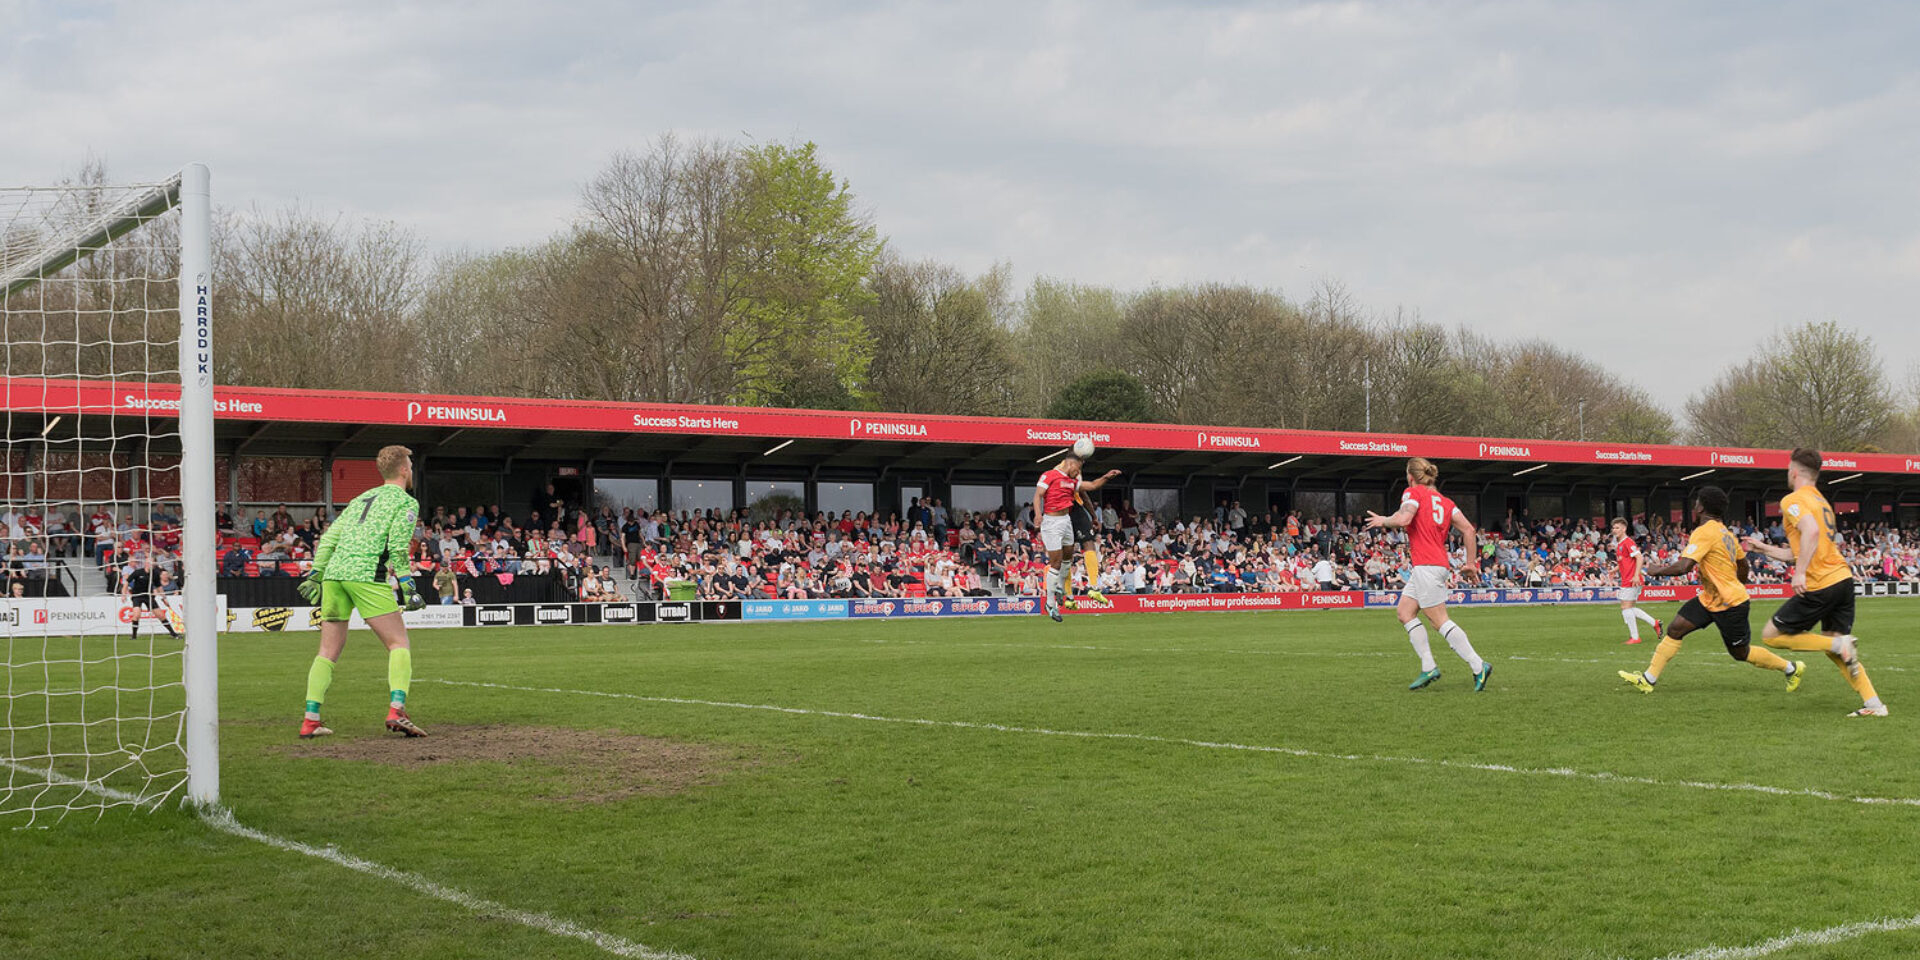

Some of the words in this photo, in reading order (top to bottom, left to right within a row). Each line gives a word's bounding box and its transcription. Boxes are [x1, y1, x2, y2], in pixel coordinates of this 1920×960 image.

[196, 285, 208, 349] HARROD
[198, 353, 208, 373] UK
[125, 395, 181, 410] Success
[229, 399, 262, 413] Here
[428, 406, 506, 422] PENINSULA
[633, 414, 677, 427] Success
[679, 416, 712, 428] Starts
[713, 417, 739, 429] Here
[866, 423, 928, 436] PENINSULA
[1026, 429, 1061, 440] Success
[1062, 430, 1088, 441] Starts
[1089, 431, 1110, 442] Here
[1210, 436, 1260, 447] PENINSULA
[1340, 440, 1367, 451] Success
[1368, 441, 1389, 452] Starts
[1390, 443, 1408, 453] Here
[1489, 446, 1530, 457] PENINSULA
[1595, 450, 1618, 460] Success
[1619, 451, 1637, 460] Starts
[1638, 452, 1652, 461] Here
[1720, 455, 1754, 465] PENINSULA
[357, 494, 379, 525] 1
[1431, 495, 1445, 525] 5
[1644, 589, 1676, 597] PENINSULA
[1759, 586, 1783, 595] business
[1138, 597, 1155, 608] The
[1156, 597, 1209, 610] employment
[1211, 597, 1225, 606] law
[1227, 595, 1281, 609] professionals
[1312, 595, 1352, 604] PENINSULA
[50, 611, 106, 621] PENINSULA
[479, 609, 511, 622] KITBAG
[538, 608, 568, 621] KITBAG
[604, 607, 633, 620] KITBAG
[659, 606, 687, 618] KITBAG
